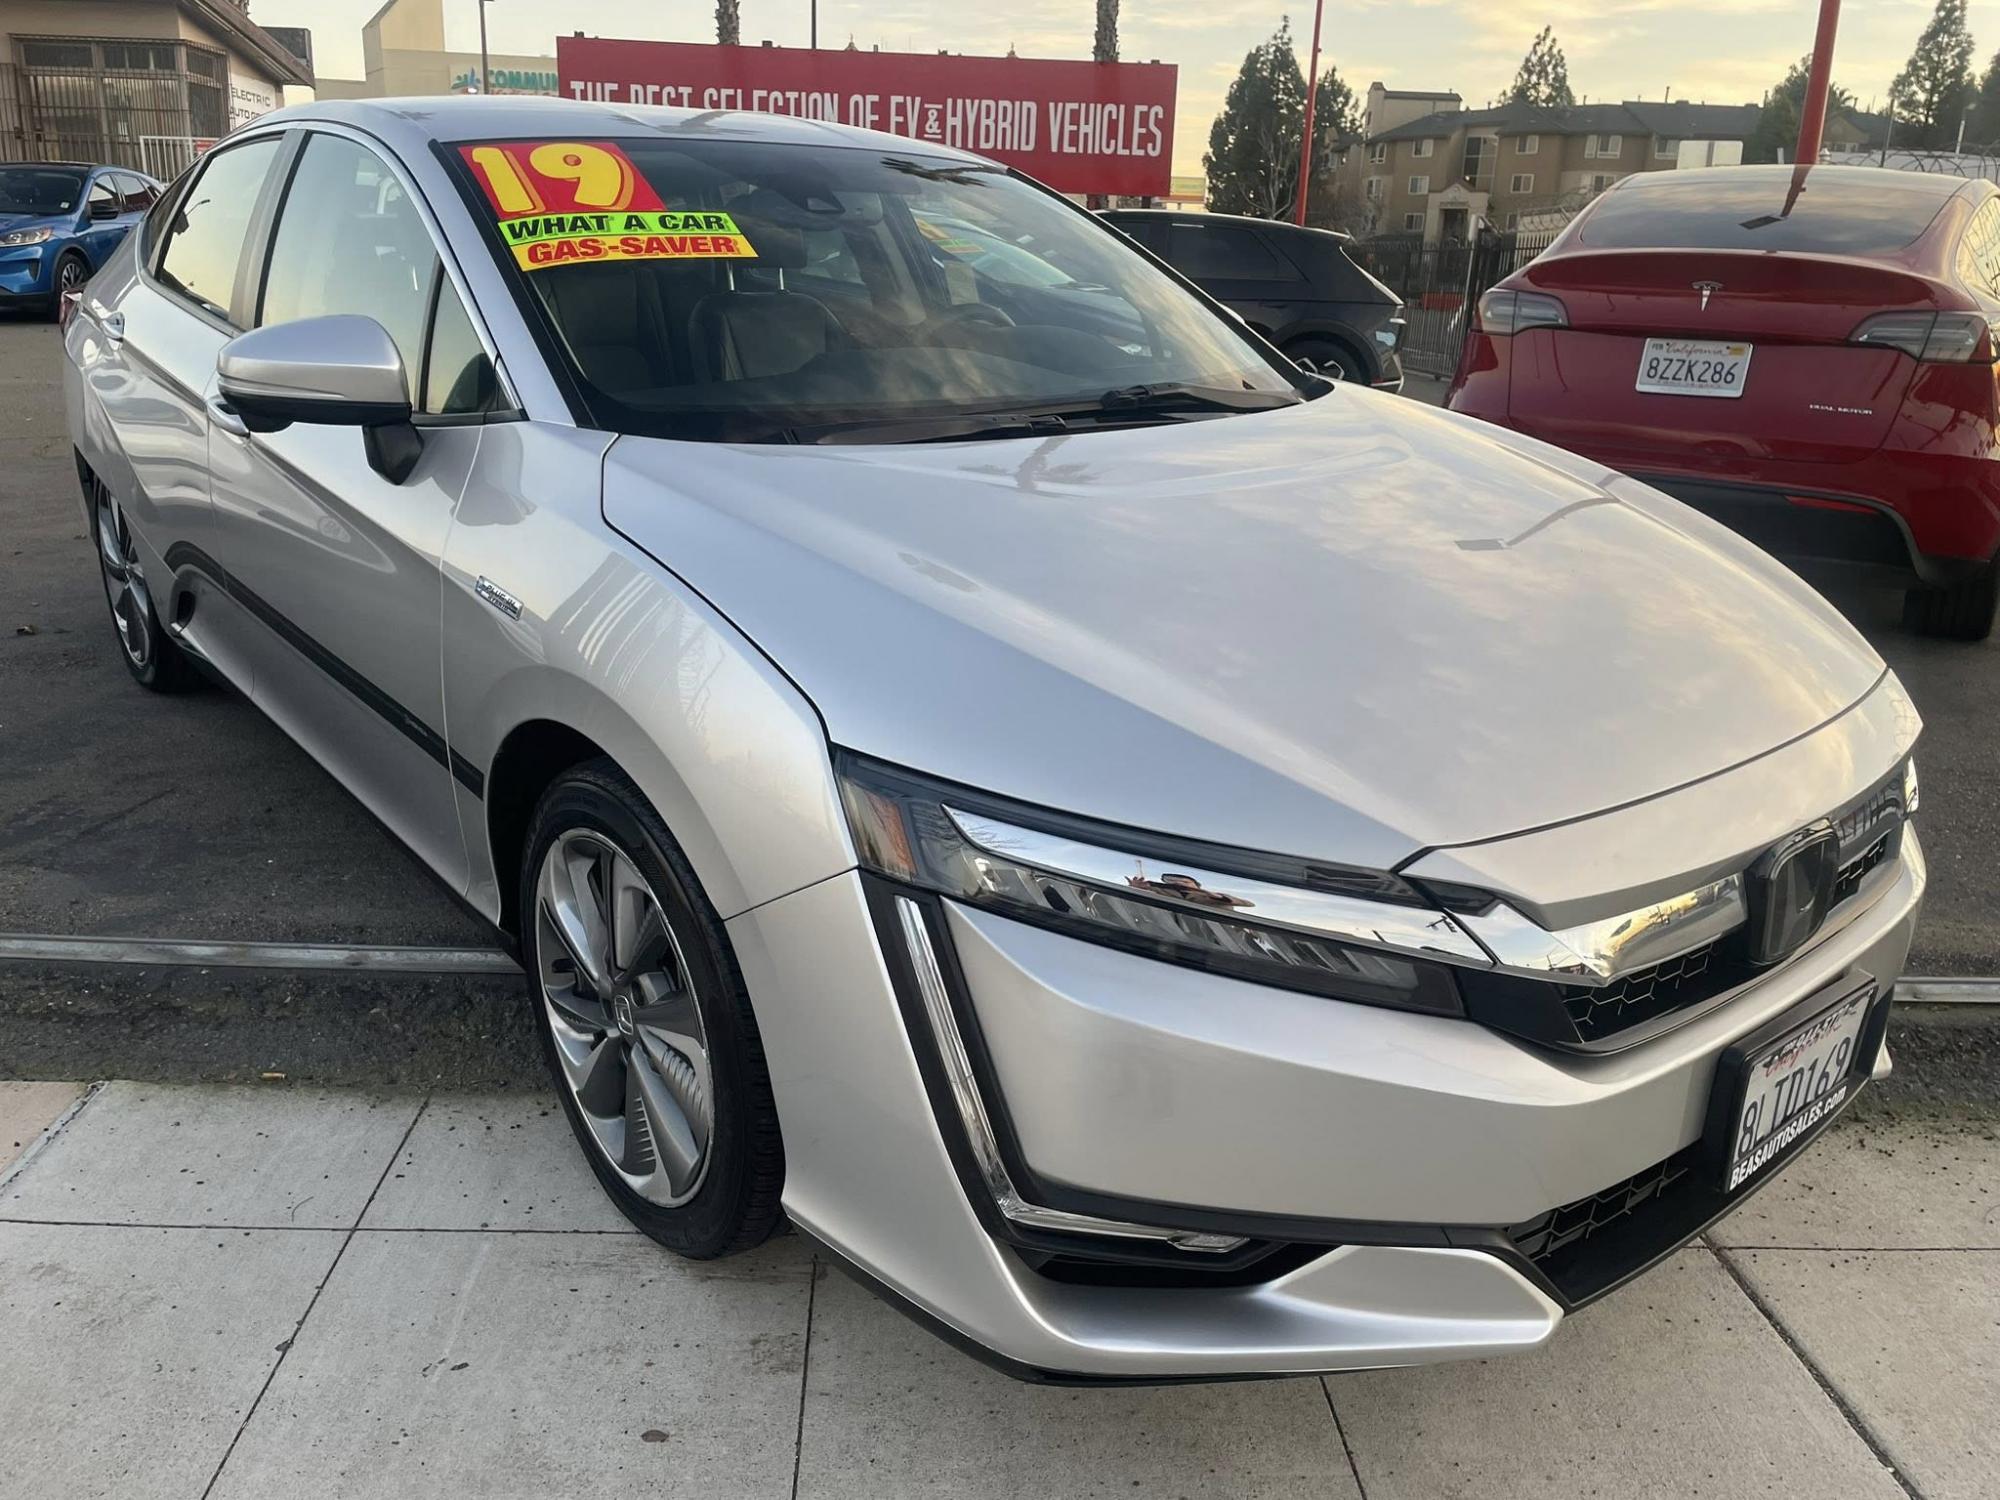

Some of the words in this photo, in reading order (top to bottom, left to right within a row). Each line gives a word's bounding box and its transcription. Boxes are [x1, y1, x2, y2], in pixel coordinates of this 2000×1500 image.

[946, 97, 1037, 151] HYBRID
[1049, 101, 1164, 157] VEHICLES
[471, 142, 630, 213] 19
[507, 215, 610, 240] WHAT
[624, 215, 647, 231] A
[658, 214, 728, 231] CAR
[528, 236, 737, 264] GAS-SAVER
[1646, 356, 1739, 384] 8ZZK286
[1738, 1036, 1851, 1157] 8LTD169
[1729, 1085, 1847, 1191] BEASAUTOSALES.com
